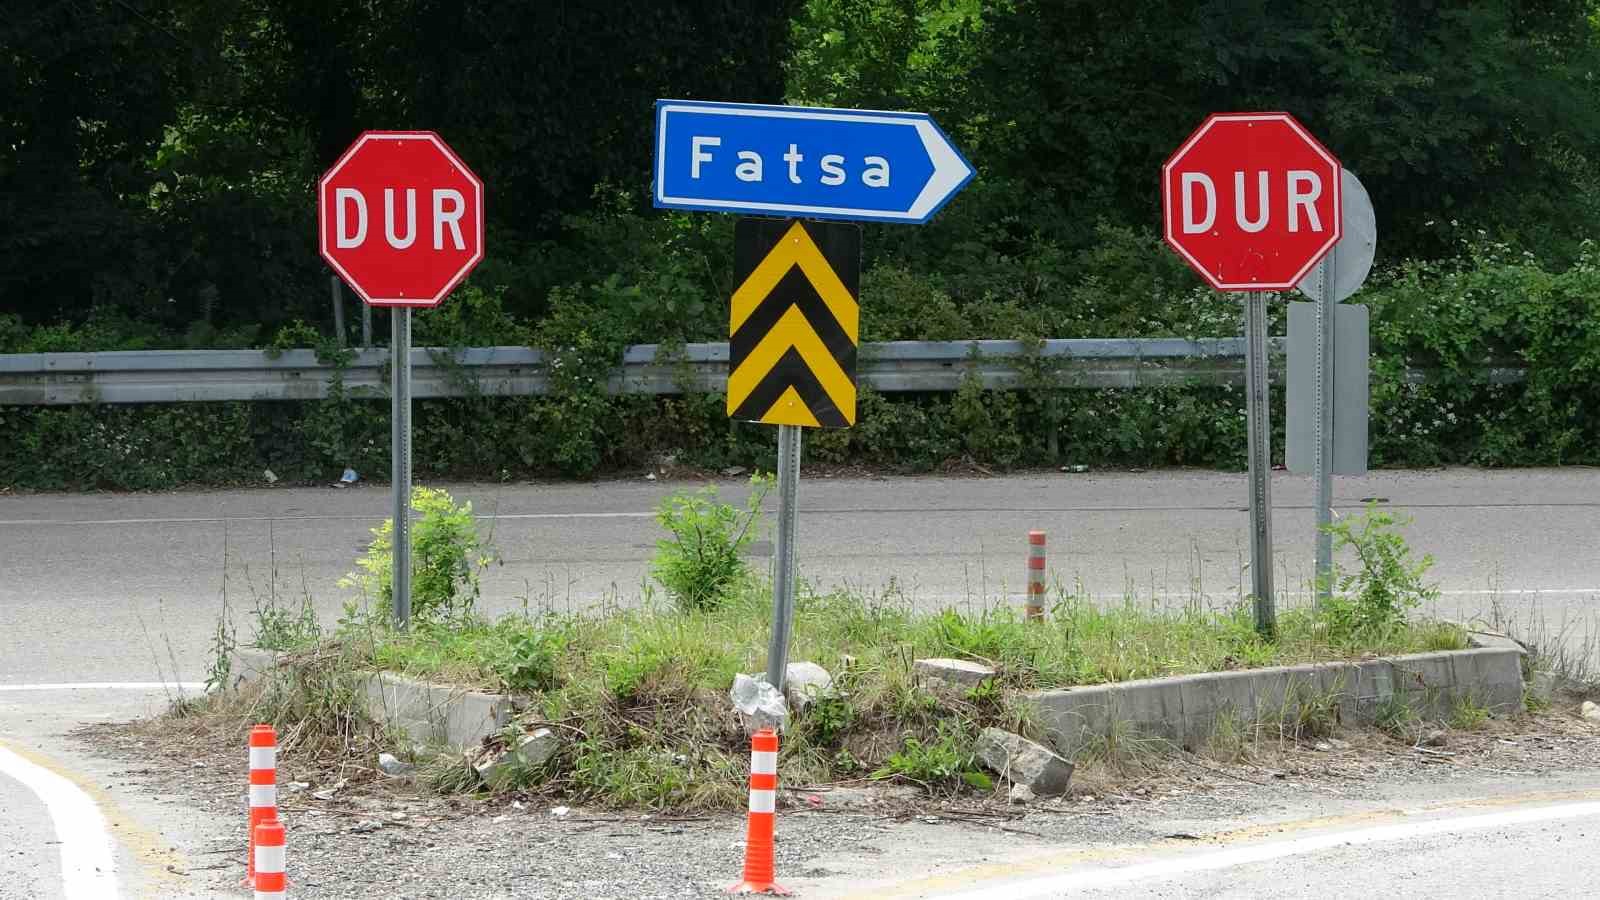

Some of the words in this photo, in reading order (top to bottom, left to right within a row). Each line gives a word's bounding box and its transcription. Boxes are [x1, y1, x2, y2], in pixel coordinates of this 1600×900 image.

[691, 136, 890, 187] Fatsa
[335, 188, 466, 250] DUR
[1181, 170, 1323, 234] DUR
